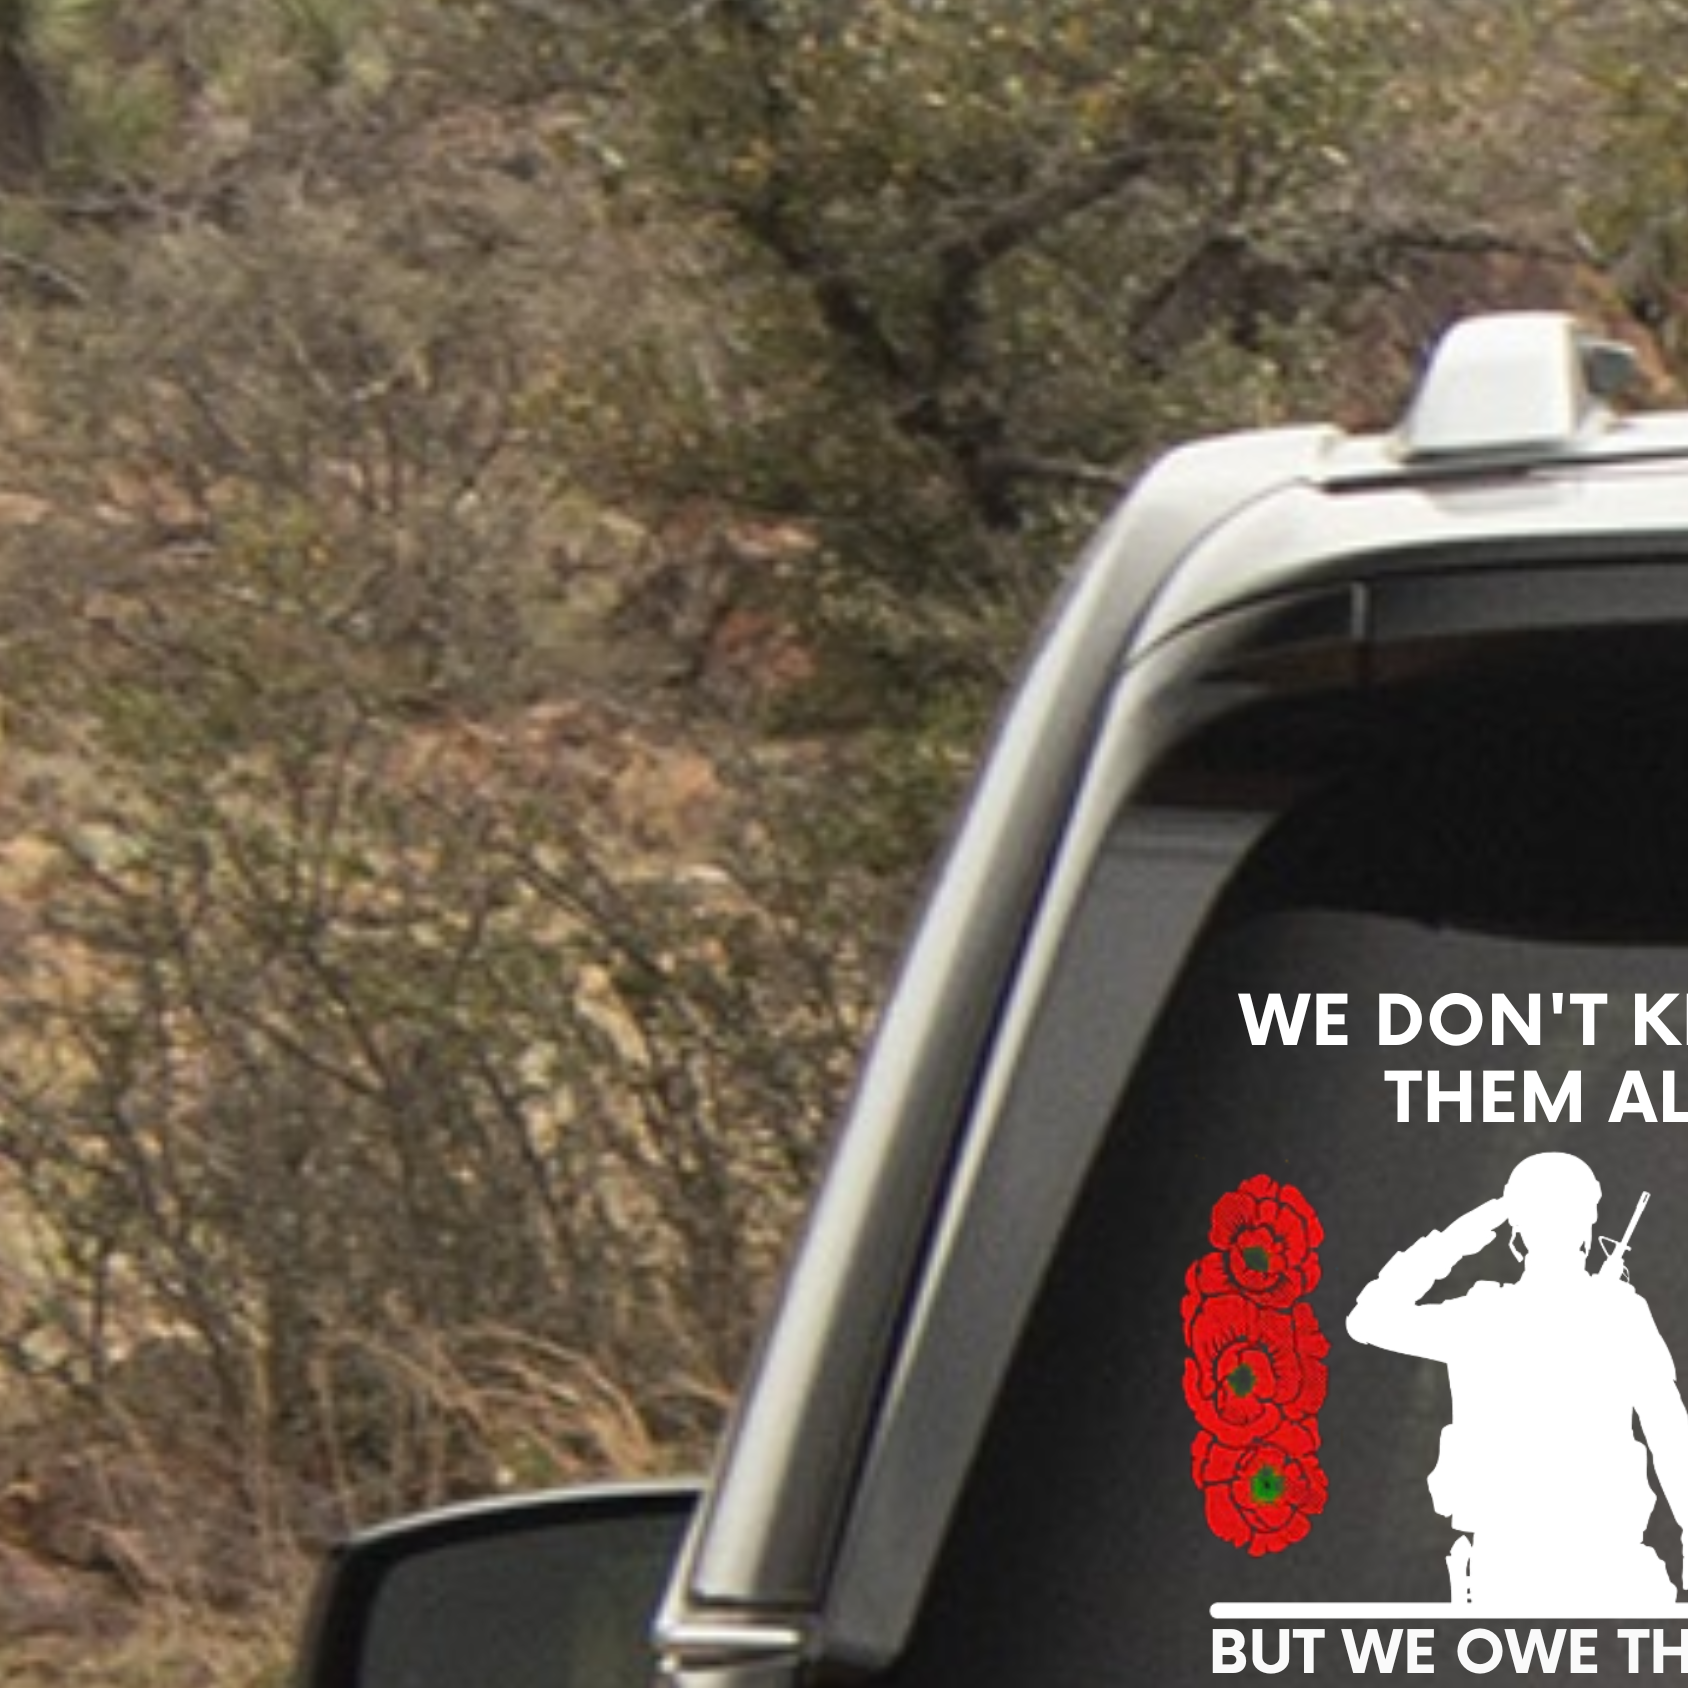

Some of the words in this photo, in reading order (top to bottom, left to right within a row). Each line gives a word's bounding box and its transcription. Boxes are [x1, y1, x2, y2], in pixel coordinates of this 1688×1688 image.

[1238, 993, 1348, 1046] WE
[1378, 992, 1608, 1047] DON'T
[1384, 1070, 1582, 1123] THEM
[1211, 1628, 1326, 1675] BUT
[1340, 1628, 1435, 1674] WE
[1456, 1627, 1598, 1675] OWE
